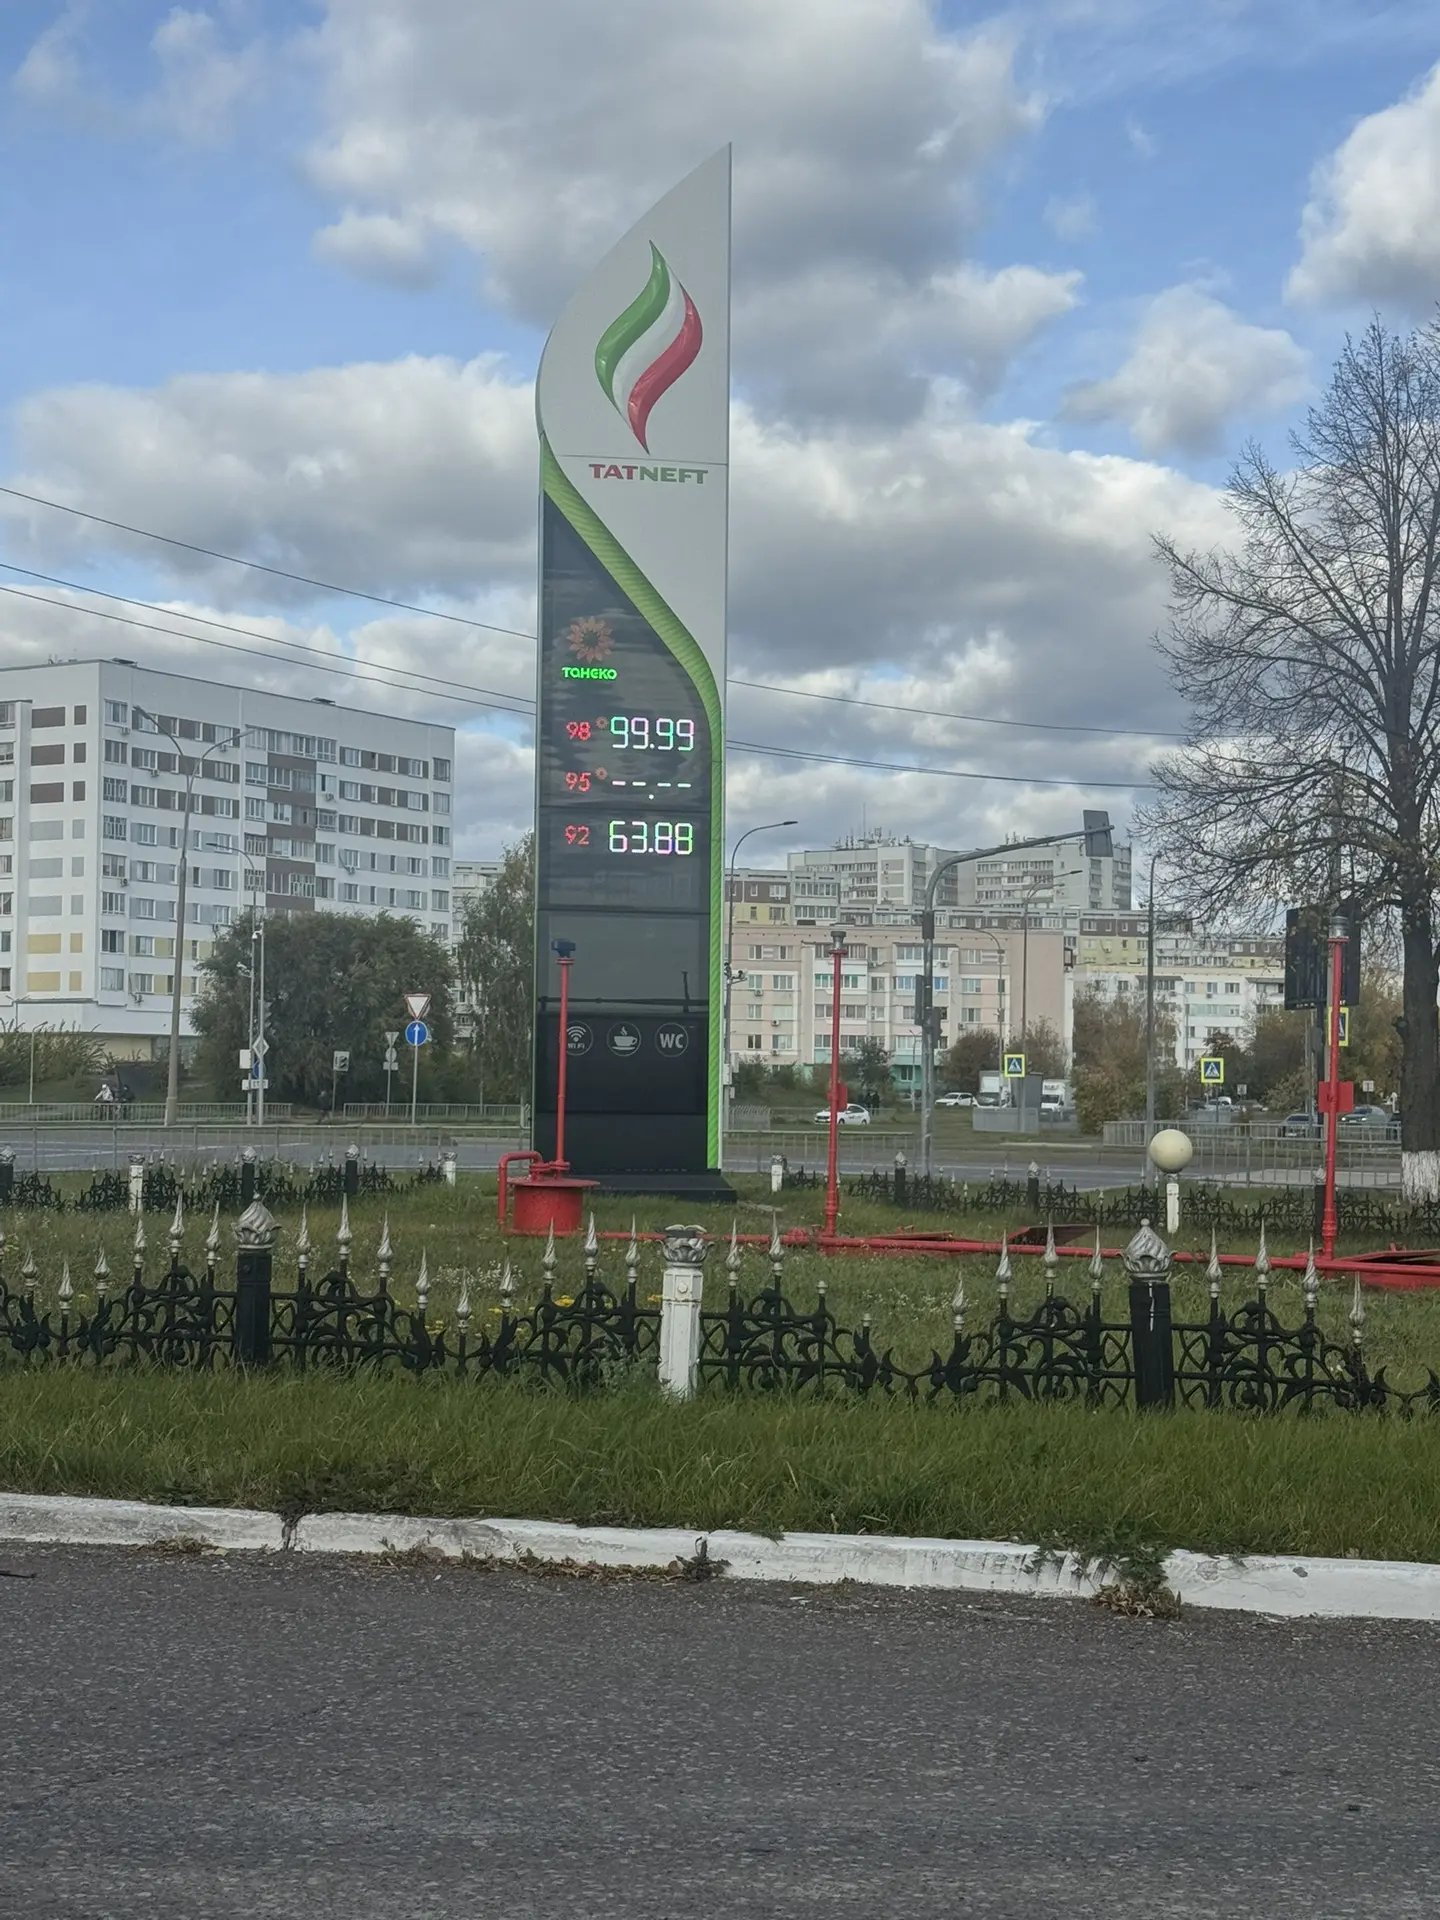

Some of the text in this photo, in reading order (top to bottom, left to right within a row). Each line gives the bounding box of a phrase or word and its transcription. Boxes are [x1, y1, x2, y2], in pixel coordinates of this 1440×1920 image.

[589, 463, 709, 485] TATNEFT
[566, 716, 695, 751] 98 99.99
[565, 772, 591, 792] 95
[565, 820, 693, 855] 92 63.88
[660, 1033, 684, 1049] WC
